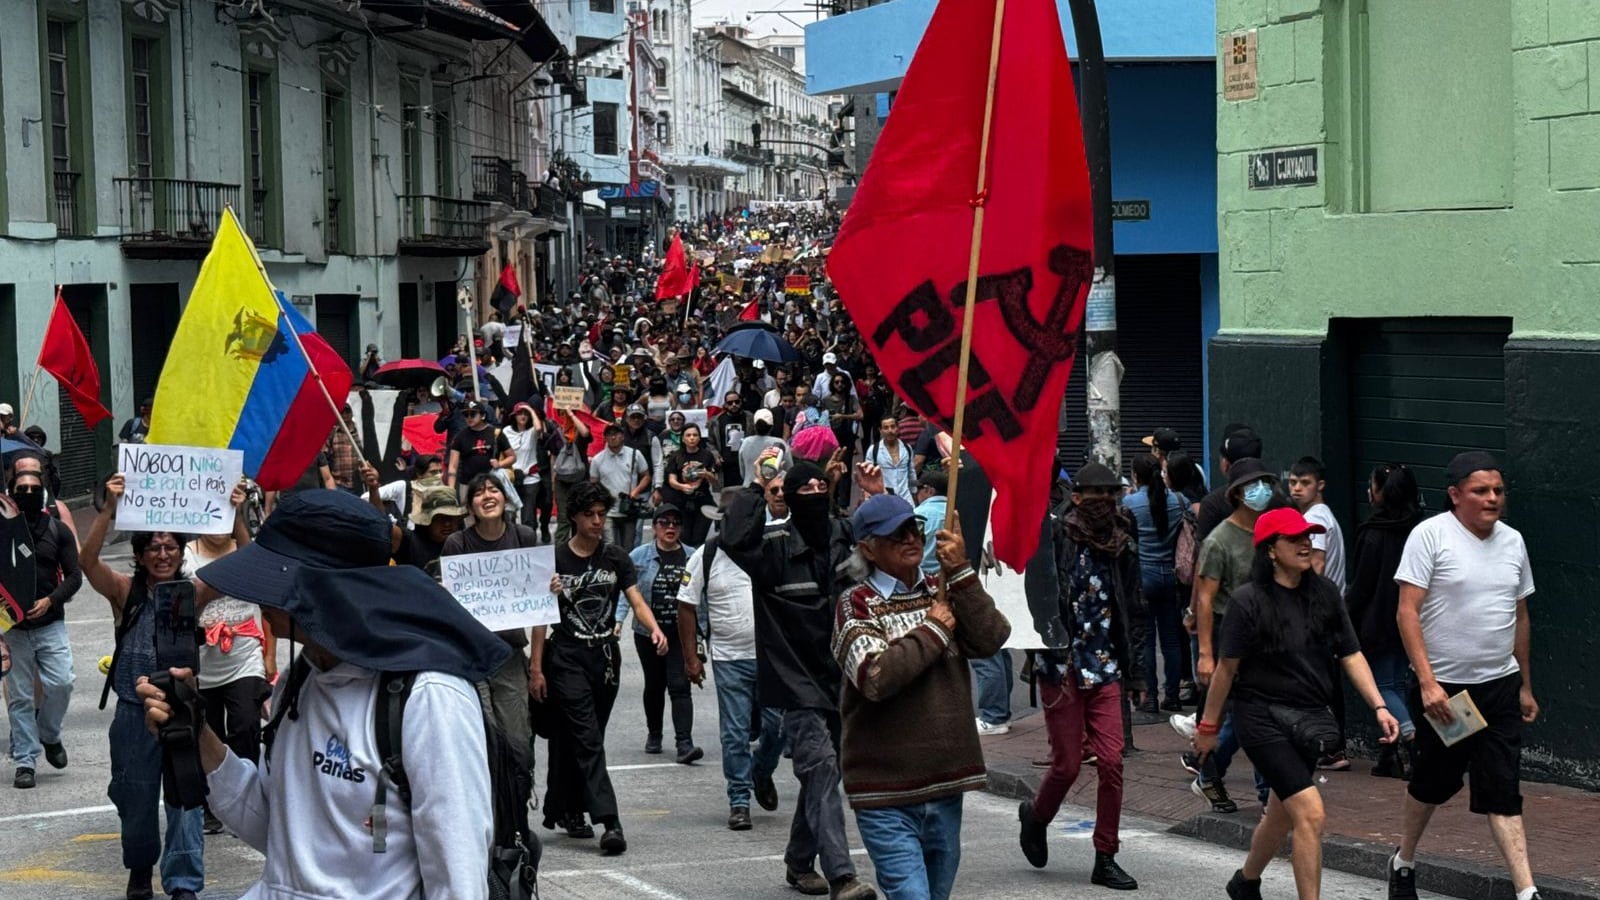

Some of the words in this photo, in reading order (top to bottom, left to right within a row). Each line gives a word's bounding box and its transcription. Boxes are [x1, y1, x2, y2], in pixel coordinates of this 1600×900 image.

[139, 474, 156, 490] de
[189, 474, 201, 491] el
[150, 496, 166, 508] es
[170, 492, 188, 508] tu
[448, 561, 473, 580] SIN
[478, 557, 501, 577] LUZ
[503, 553, 531, 573] SIN
[453, 577, 510, 593] DIGNIDAD
[525, 573, 532, 584] A
[513, 587, 528, 598] LA
[511, 596, 554, 613] POPULAR
[313, 751, 366, 783] Panas
